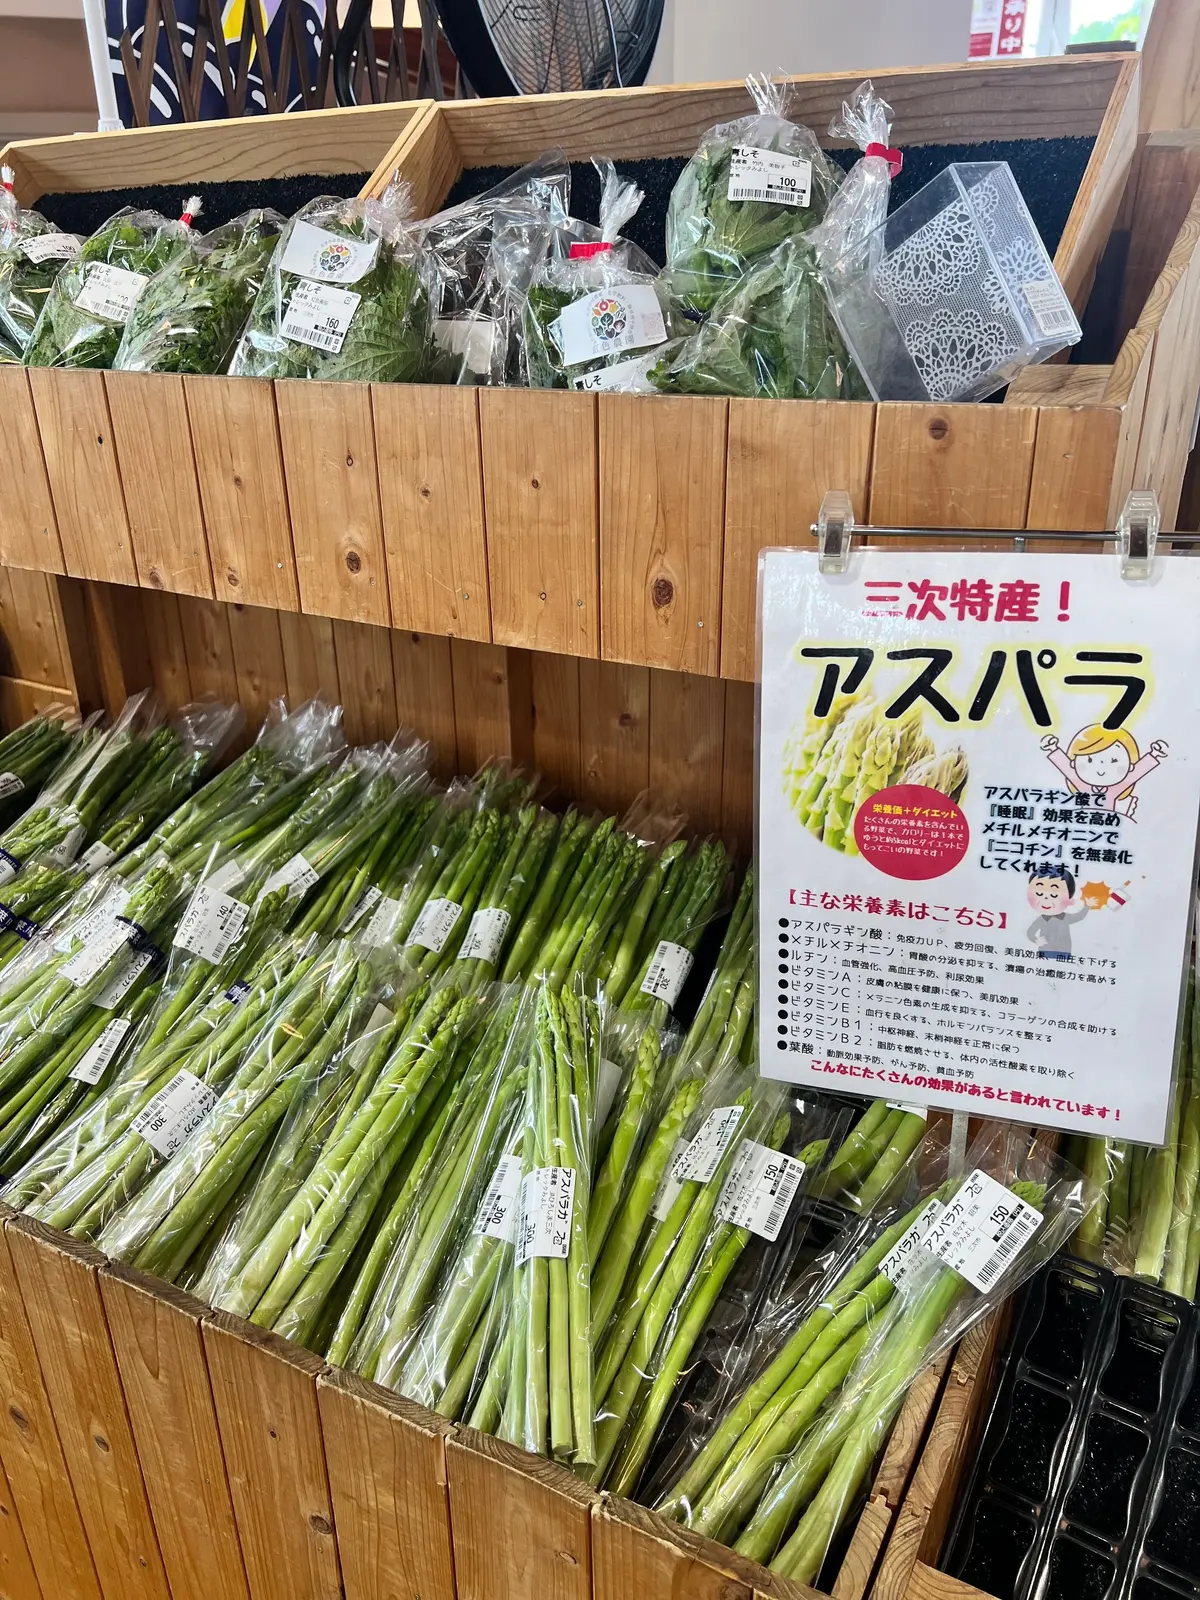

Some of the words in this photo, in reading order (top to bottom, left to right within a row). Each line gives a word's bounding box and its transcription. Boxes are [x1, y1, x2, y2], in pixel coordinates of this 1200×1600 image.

[780, 177, 796, 187] 100
[326, 317, 339, 330] 160
[861, 578, 1071, 622] 三次特産！
[800, 646, 1146, 731] アスパラ
[984, 786, 1107, 807] アスパラギン酸で
[872, 803, 958, 819] 栄養価＋ダイエット
[989, 803, 1121, 828] 『睡眠』効果を高め
[982, 821, 1119, 845] メチルメチオニンで
[863, 843, 944, 857] もってこいの野菜です！
[987, 838, 1133, 865] 『ニコチン』を無毒化
[980, 855, 1079, 877] してくれます！
[216, 904, 229, 919] 140
[789, 888, 1007, 930] 【主な栄養素はこちら】
[659, 976, 670, 989] 300
[810, 1059, 1120, 1121] こんなにたくさんの効果があると言われています！
[149, 1114, 166, 1132] 300
[763, 1163, 778, 1181] 150
[491, 1206, 506, 1225] 300
[988, 1204, 1010, 1226] 150
[525, 1222, 535, 1244] 300
[935, 1239, 952, 1258] 生産者
[951, 1218, 968, 1237] 佐々木
